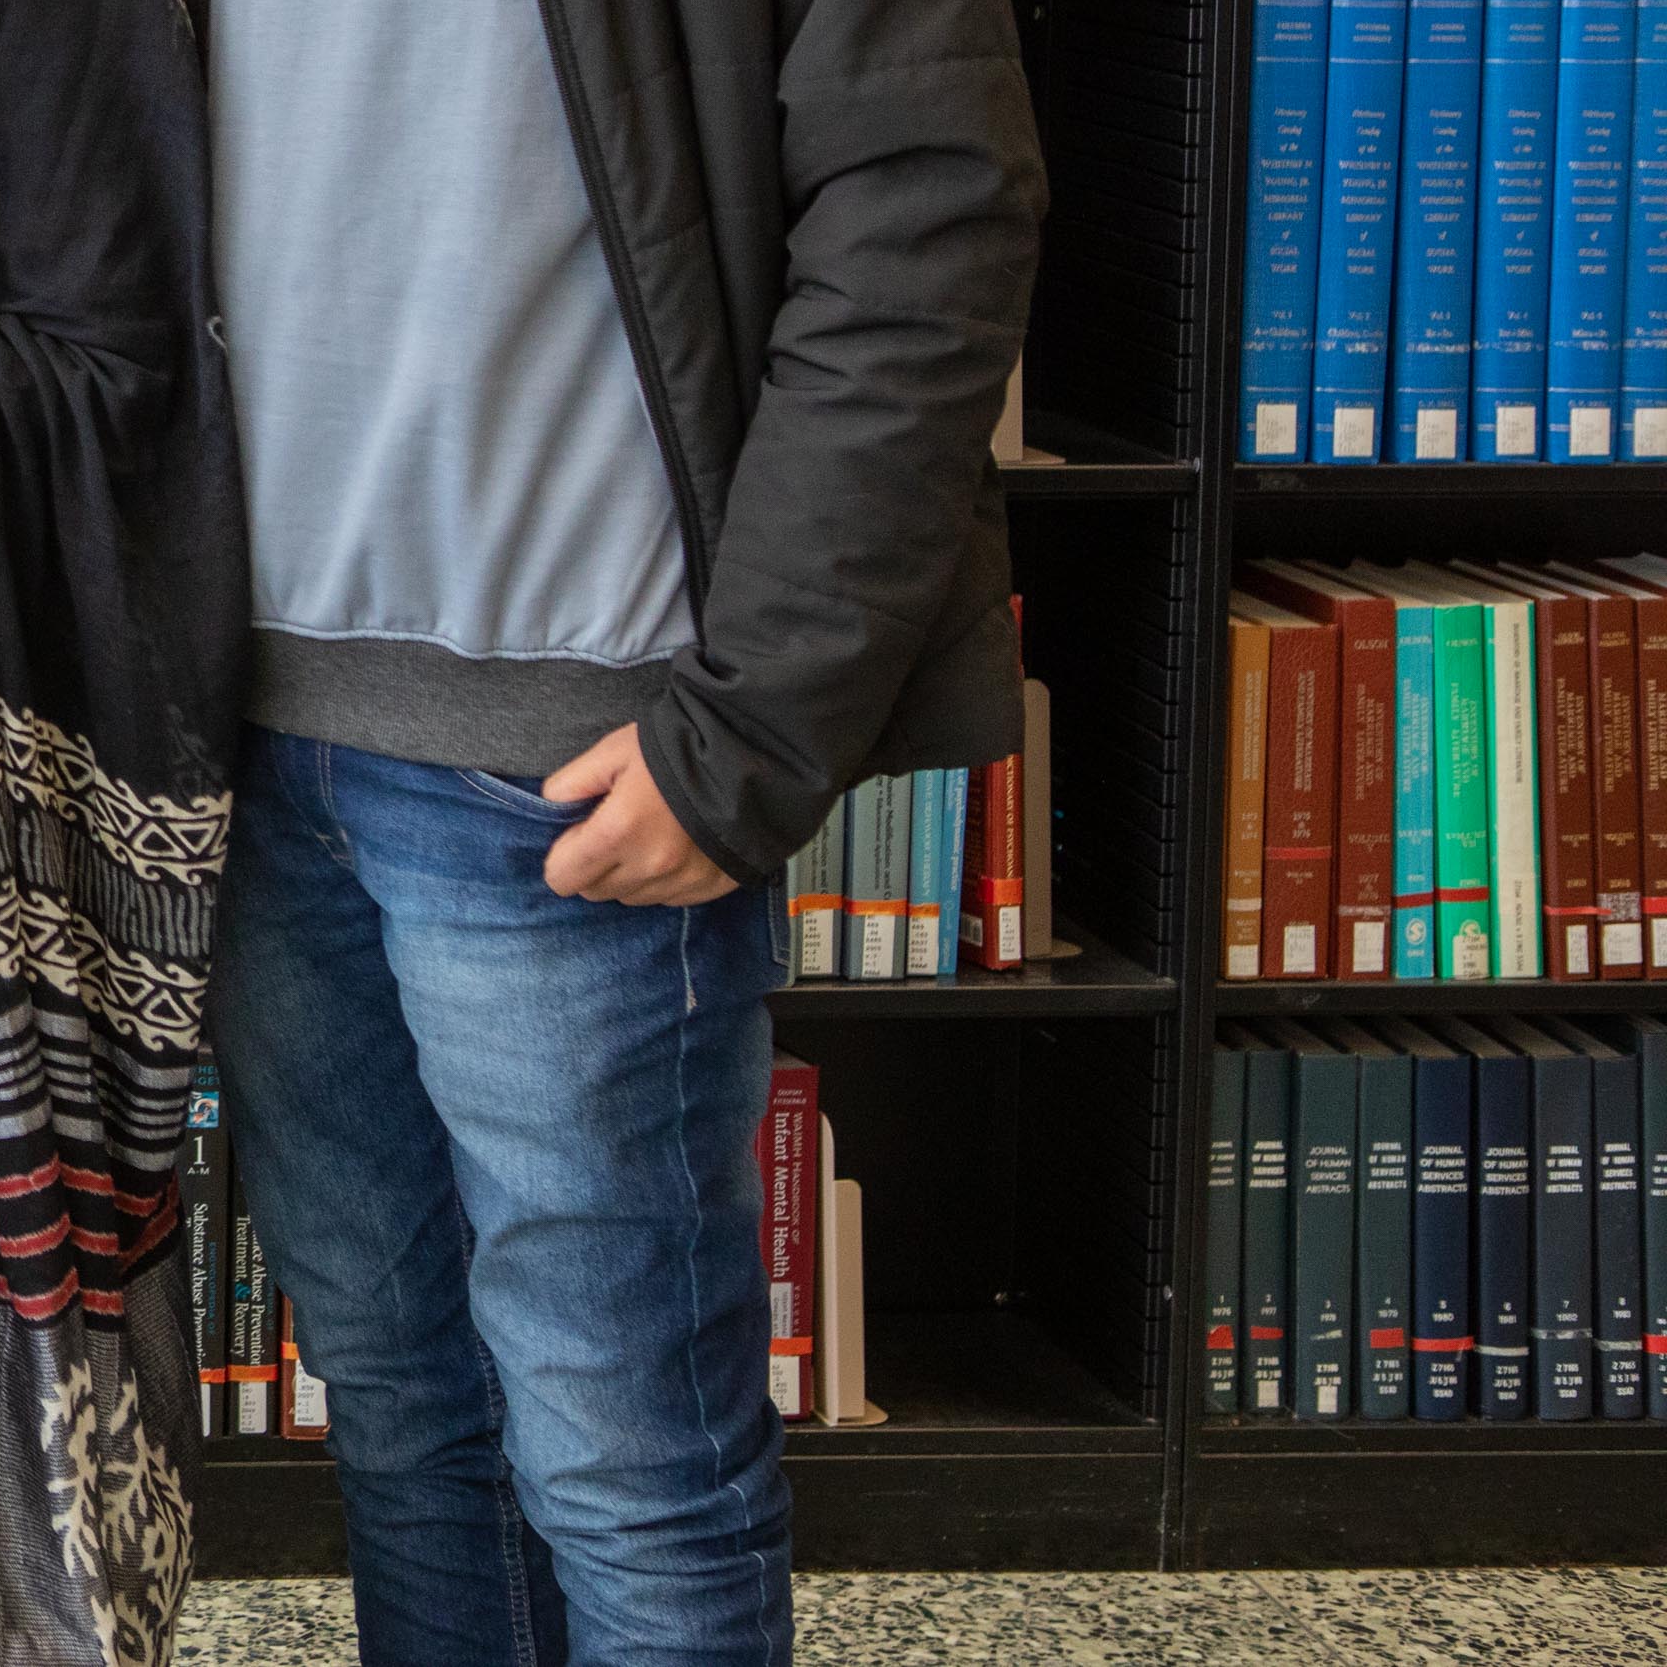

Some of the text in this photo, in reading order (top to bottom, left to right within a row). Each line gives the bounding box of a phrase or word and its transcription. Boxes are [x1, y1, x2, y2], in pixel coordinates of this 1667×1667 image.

[193, 1136, 205, 1165] 1
[1420, 1158, 1466, 1168] OF HUMAN
[1423, 1146, 1464, 1154] JOURNAL
[1417, 1184, 1467, 1193] ABSTRACTS
[1421, 1171, 1465, 1180] SERVICES
[773, 1112, 790, 1278] Infant Mental Health
[792, 1162, 803, 1225] HANDBOOK
[193, 1203, 208, 1305] Substance Abuse
[232, 1215, 251, 1357] Treatment, & Recovery
